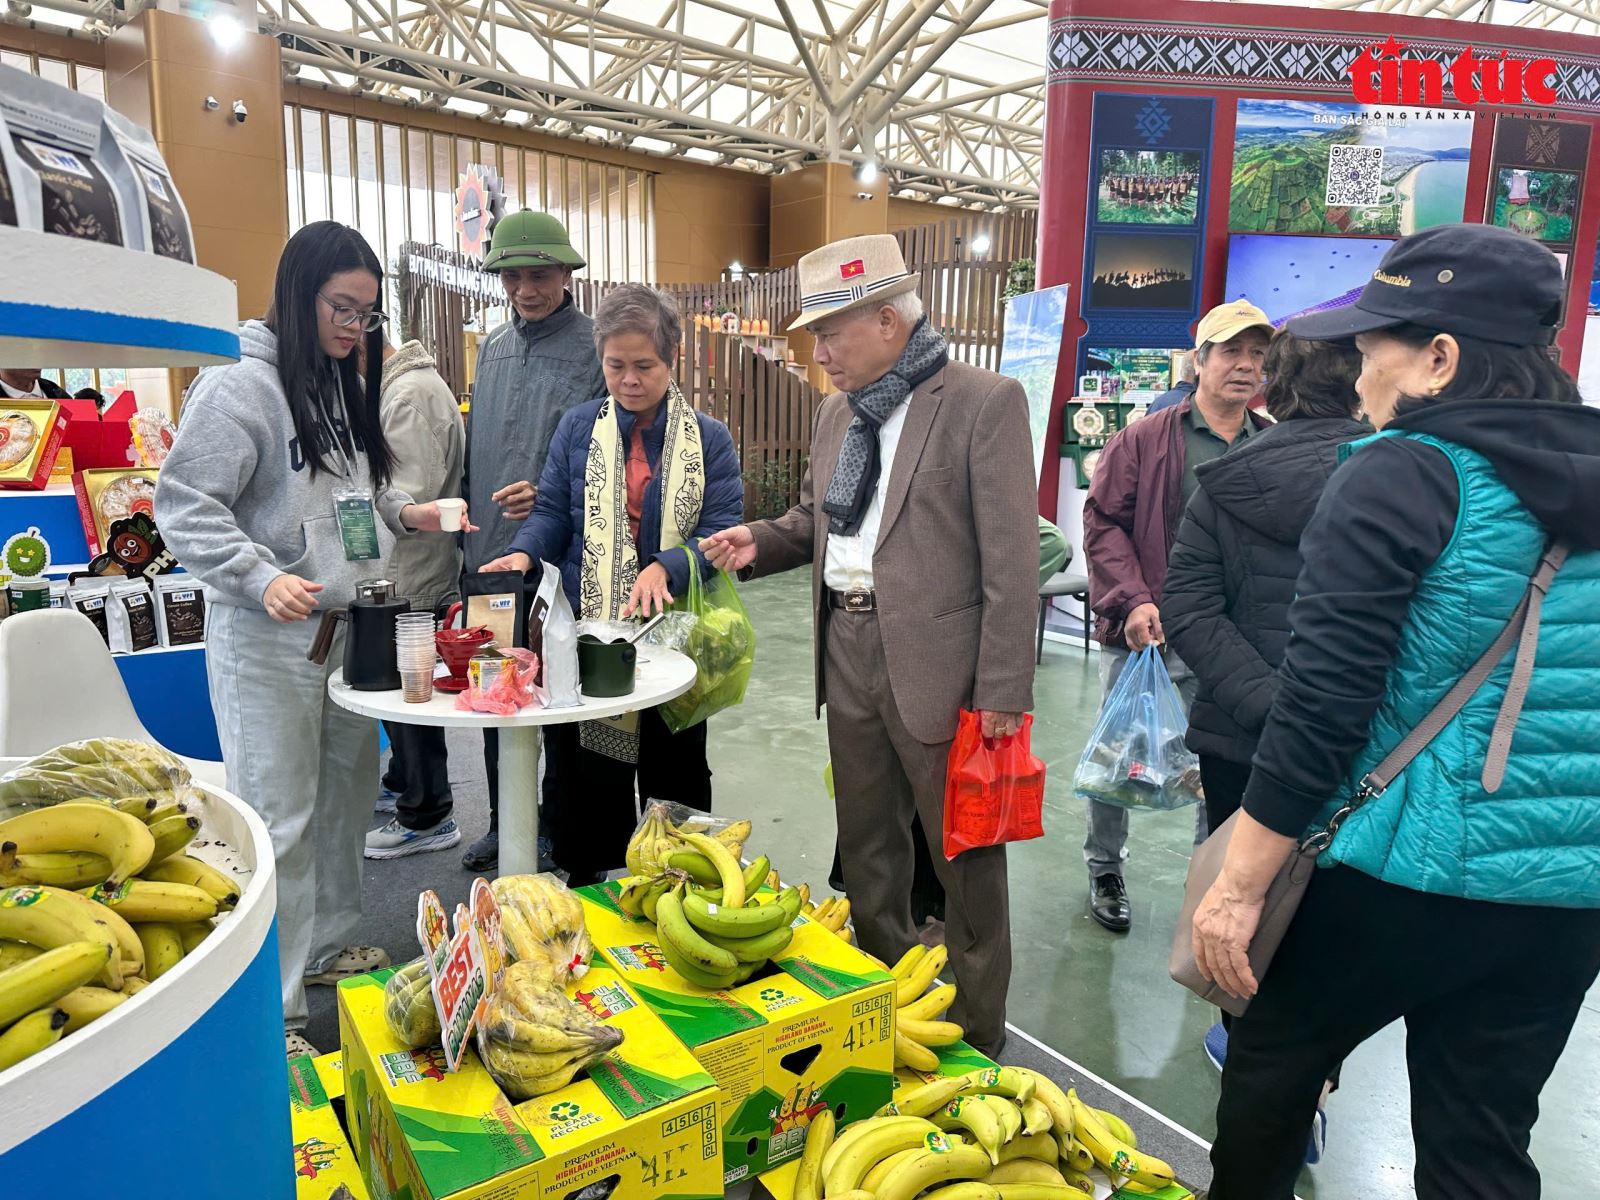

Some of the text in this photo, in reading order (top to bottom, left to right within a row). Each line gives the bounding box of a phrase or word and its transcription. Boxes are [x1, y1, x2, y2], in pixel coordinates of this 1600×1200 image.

[1374, 269, 1411, 287] Columbia
[438, 931, 474, 1023] BEST
[593, 985, 634, 1015] BBF
[854, 994, 889, 1014] 4 5 6 7
[883, 1006, 889, 1016] 8
[775, 1020, 827, 1043] HIGHLAND BANANA
[782, 1016, 820, 1033] PREMIUM
[882, 1017, 888, 1027] 9
[767, 1039, 797, 1054] PRODUCT
[807, 1026, 835, 1040] VIETNAM
[881, 1028, 890, 1039] CL
[385, 1050, 424, 1083] BBF
[550, 1112, 595, 1133] PLEASE
[550, 1116, 604, 1139] RECYCLE
[665, 1105, 713, 1134] 4 5 6 7
[705, 1118, 713, 1130] 8
[706, 1131, 713, 1143] 9
[564, 1142, 616, 1168] PREMIUM
[705, 1144, 716, 1157] CL
[544, 1173, 585, 1194] PRODUCT
[587, 1166, 599, 1177] OF
[600, 1151, 637, 1172] VIETNAM
[555, 1146, 626, 1182] HIGHLAND BANANA
